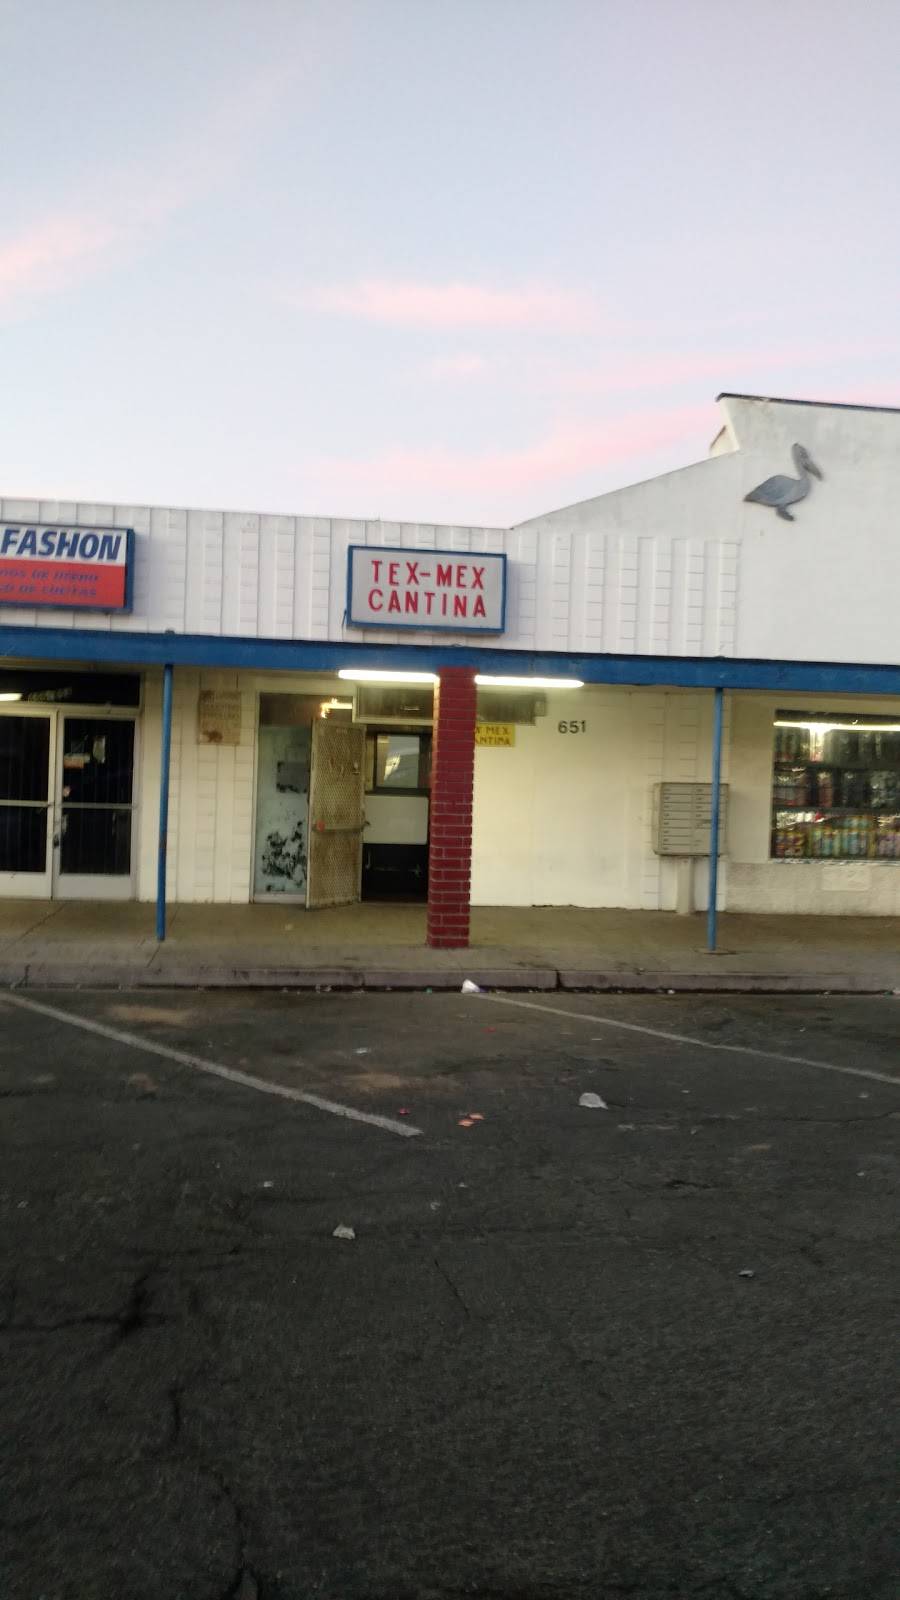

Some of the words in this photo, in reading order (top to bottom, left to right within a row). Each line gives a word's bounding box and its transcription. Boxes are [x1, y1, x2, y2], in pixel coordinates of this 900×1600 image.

[0, 529, 121, 560] FASHON
[371, 560, 486, 590] TEX-MEX
[368, 589, 487, 618] CANTINA
[558, 720, 586, 734] 651
